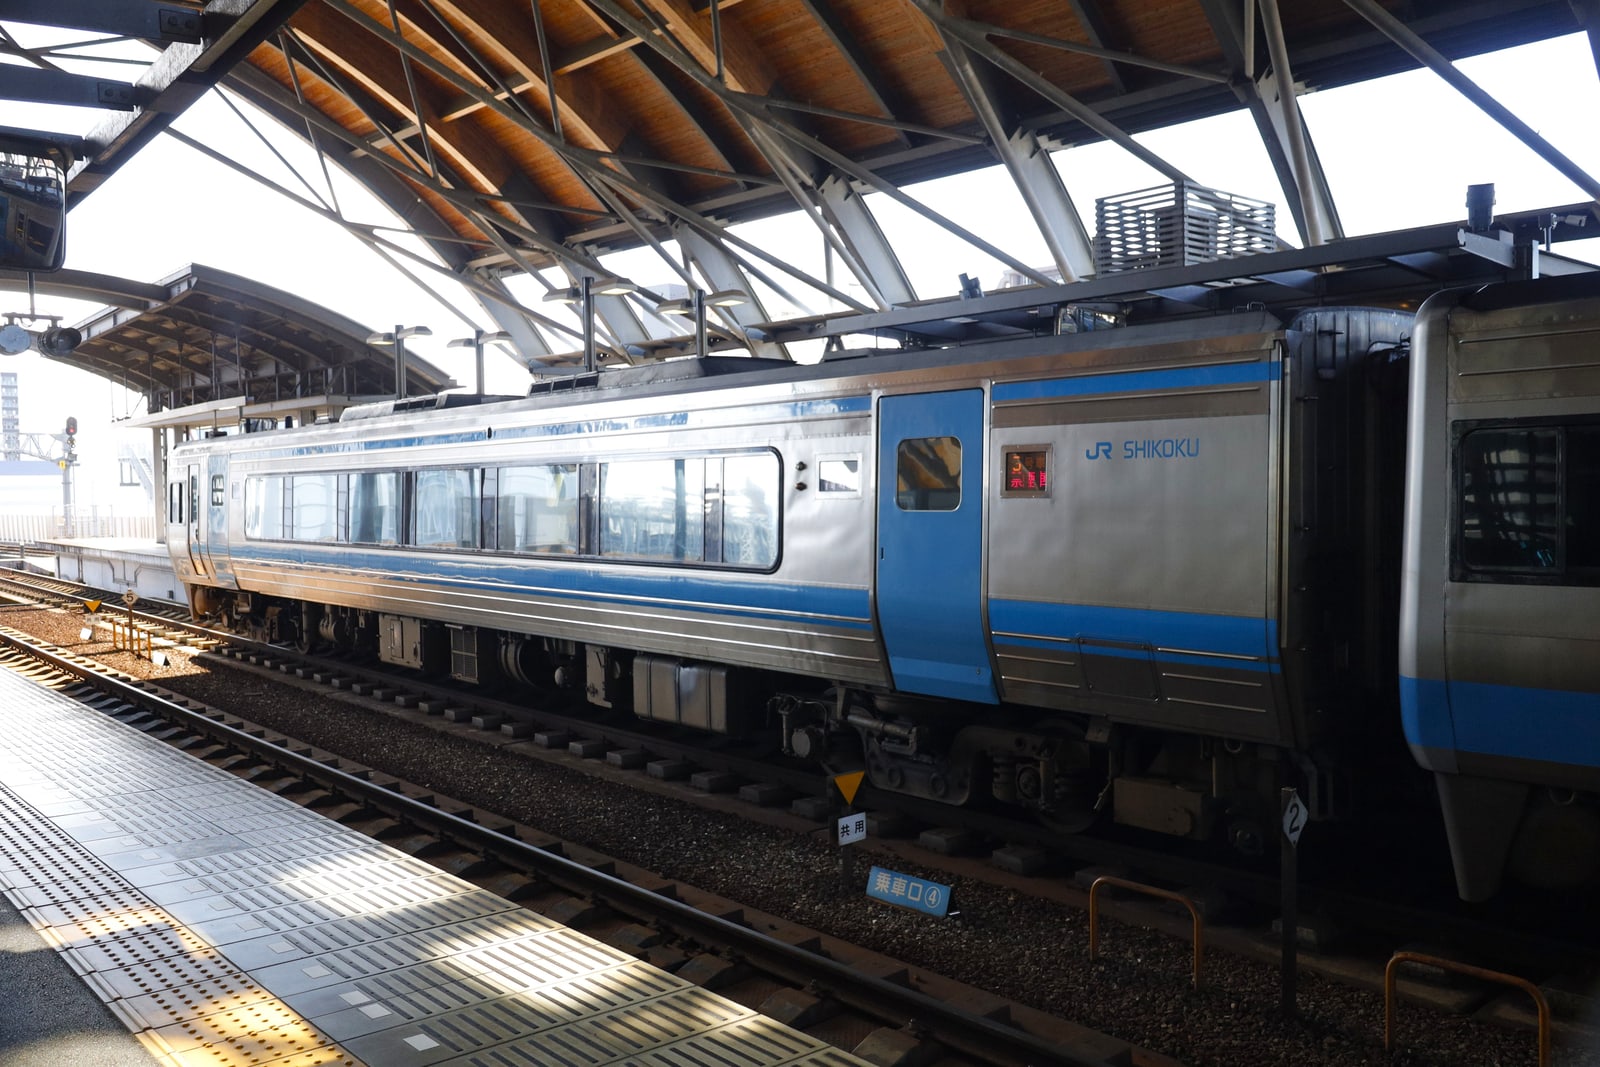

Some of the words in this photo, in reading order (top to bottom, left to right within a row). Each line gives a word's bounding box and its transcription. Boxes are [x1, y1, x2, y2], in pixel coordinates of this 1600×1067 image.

[1086, 441, 1112, 460] JR
[1123, 438, 1200, 459] SHIKOKU
[126, 593, 134, 602] 5
[1289, 803, 1300, 834] 2
[840, 820, 865, 837] 共用
